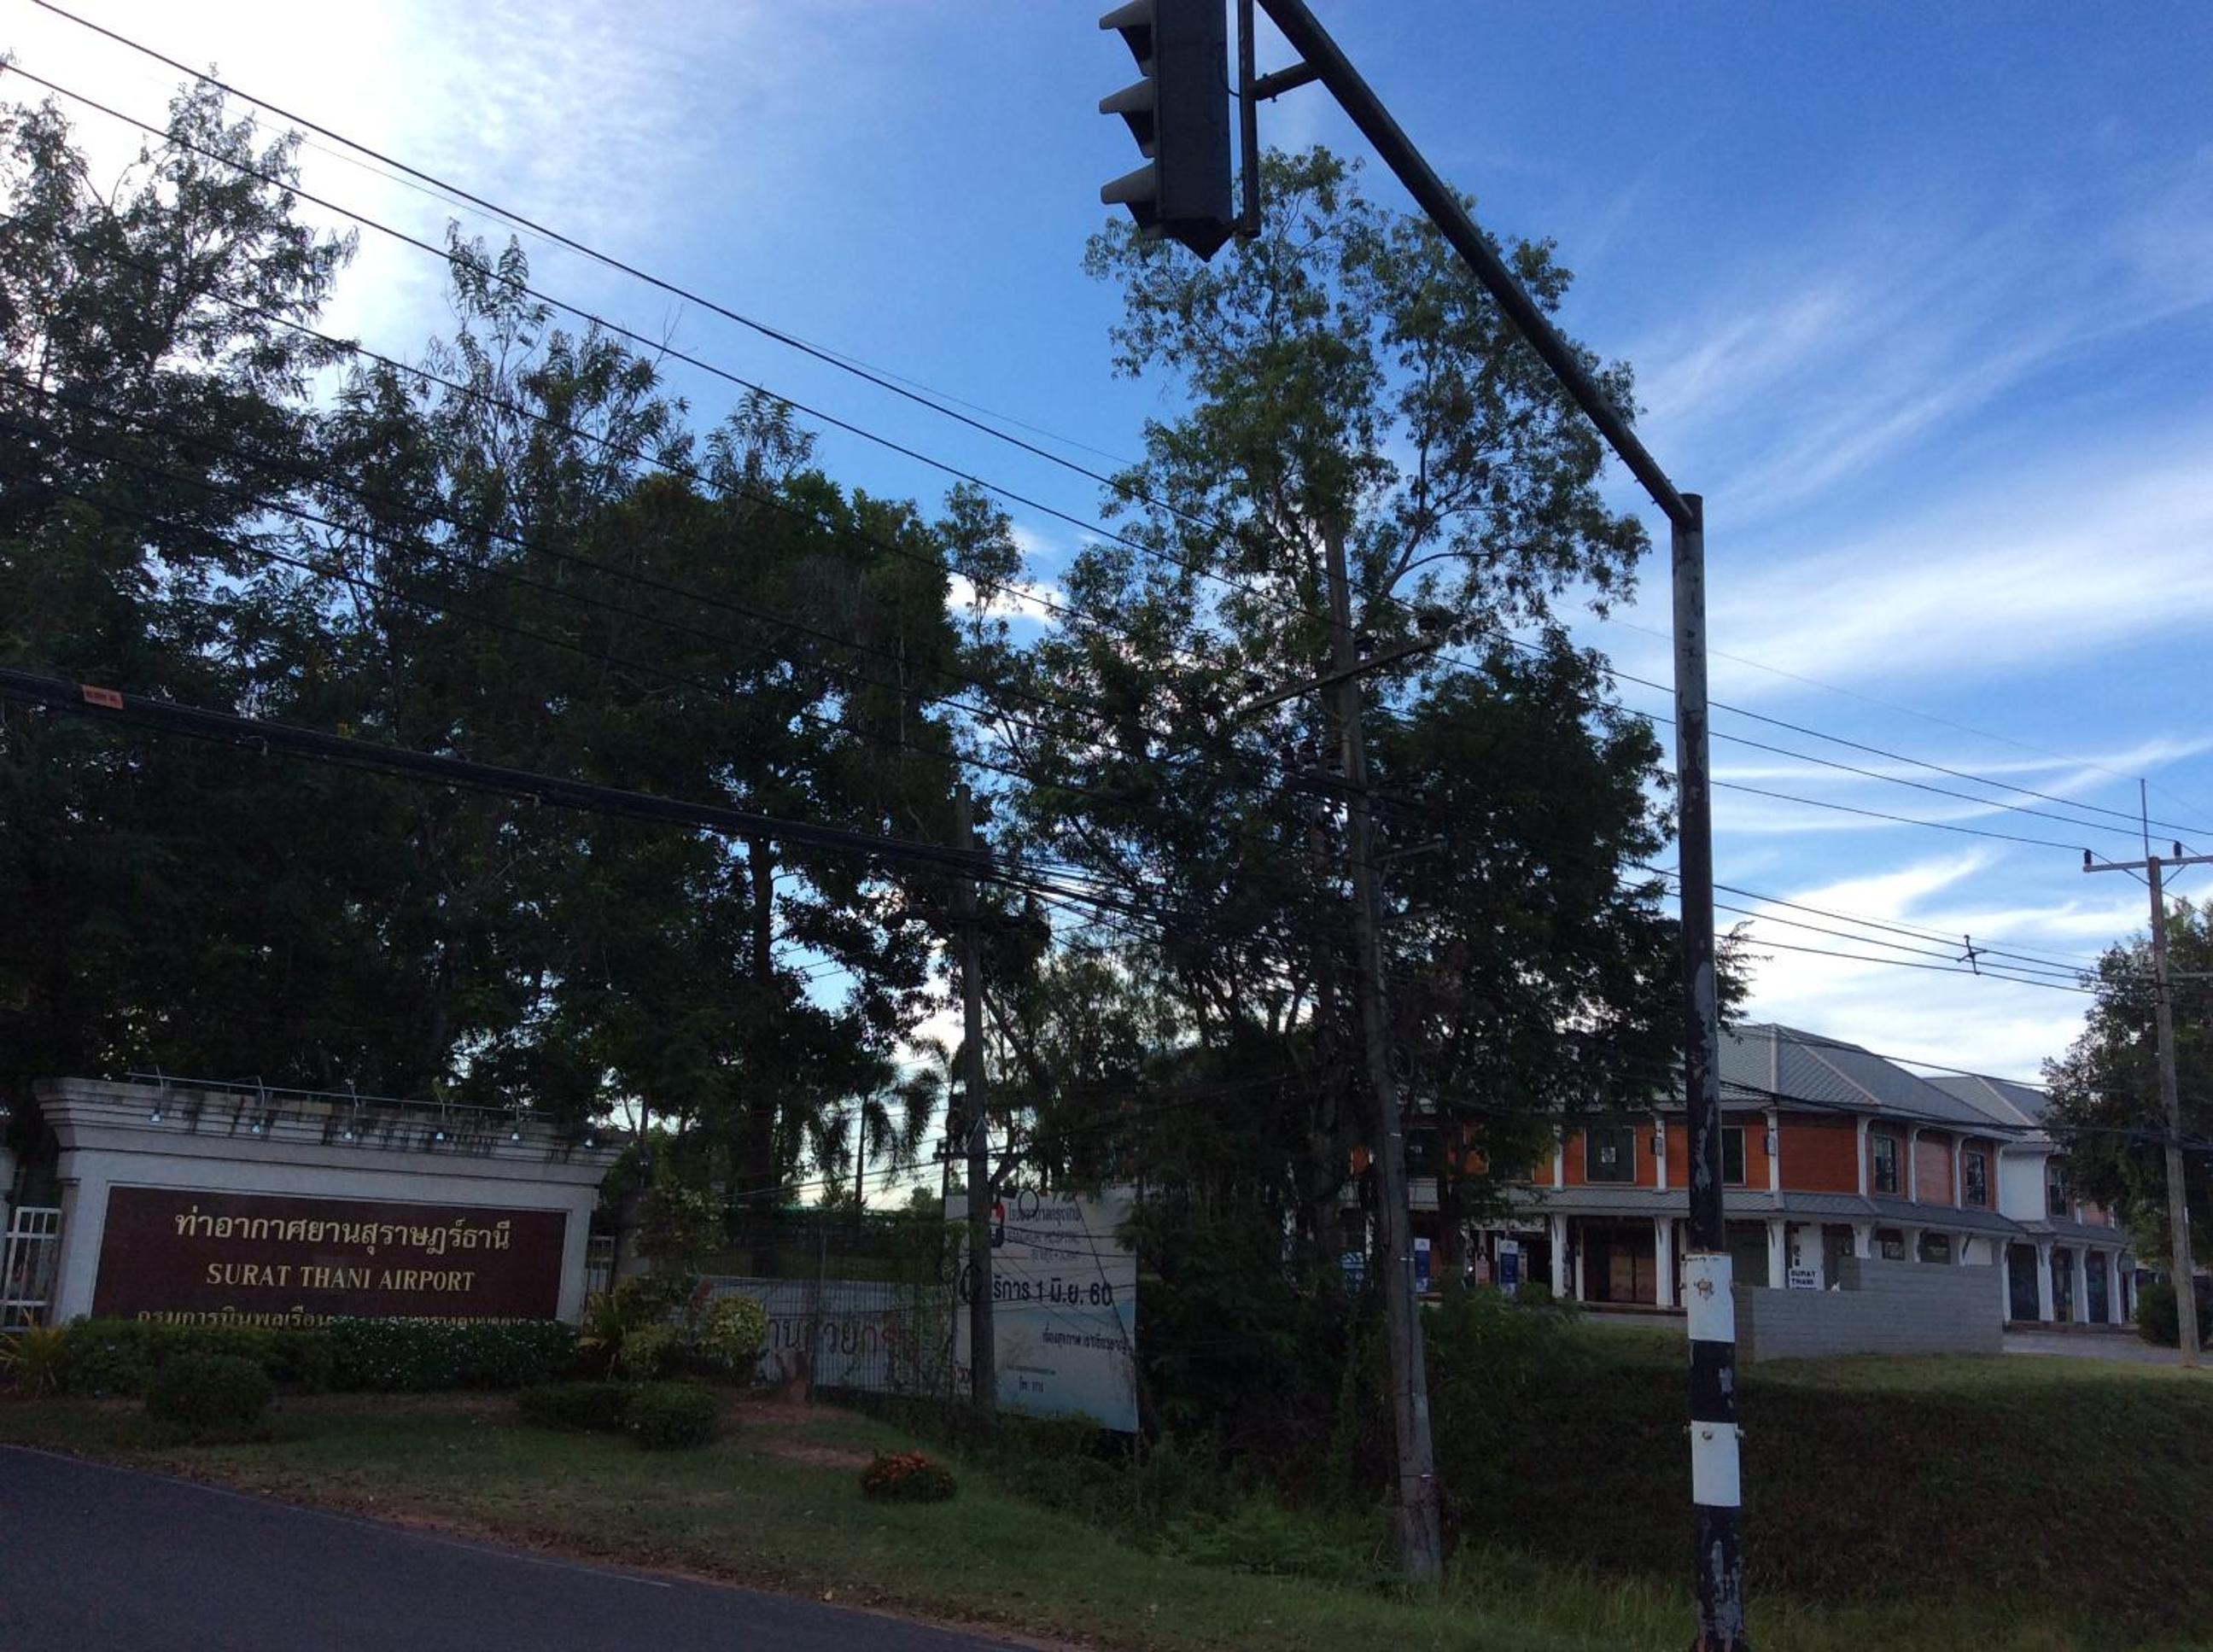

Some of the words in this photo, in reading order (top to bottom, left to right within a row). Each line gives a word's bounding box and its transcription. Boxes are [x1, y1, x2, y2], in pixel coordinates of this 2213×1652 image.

[174, 1205, 511, 1256] ท่าอากาศยานสุราษฎร์ธานี
[206, 1263, 291, 1287] SURAT
[300, 1265, 371, 1288] THANI
[379, 1270, 476, 1292] AIRPORT
[993, 1275, 1030, 1301] ริการ
[1036, 1280, 1043, 1302] 1
[1089, 1282, 1112, 1306] 60
